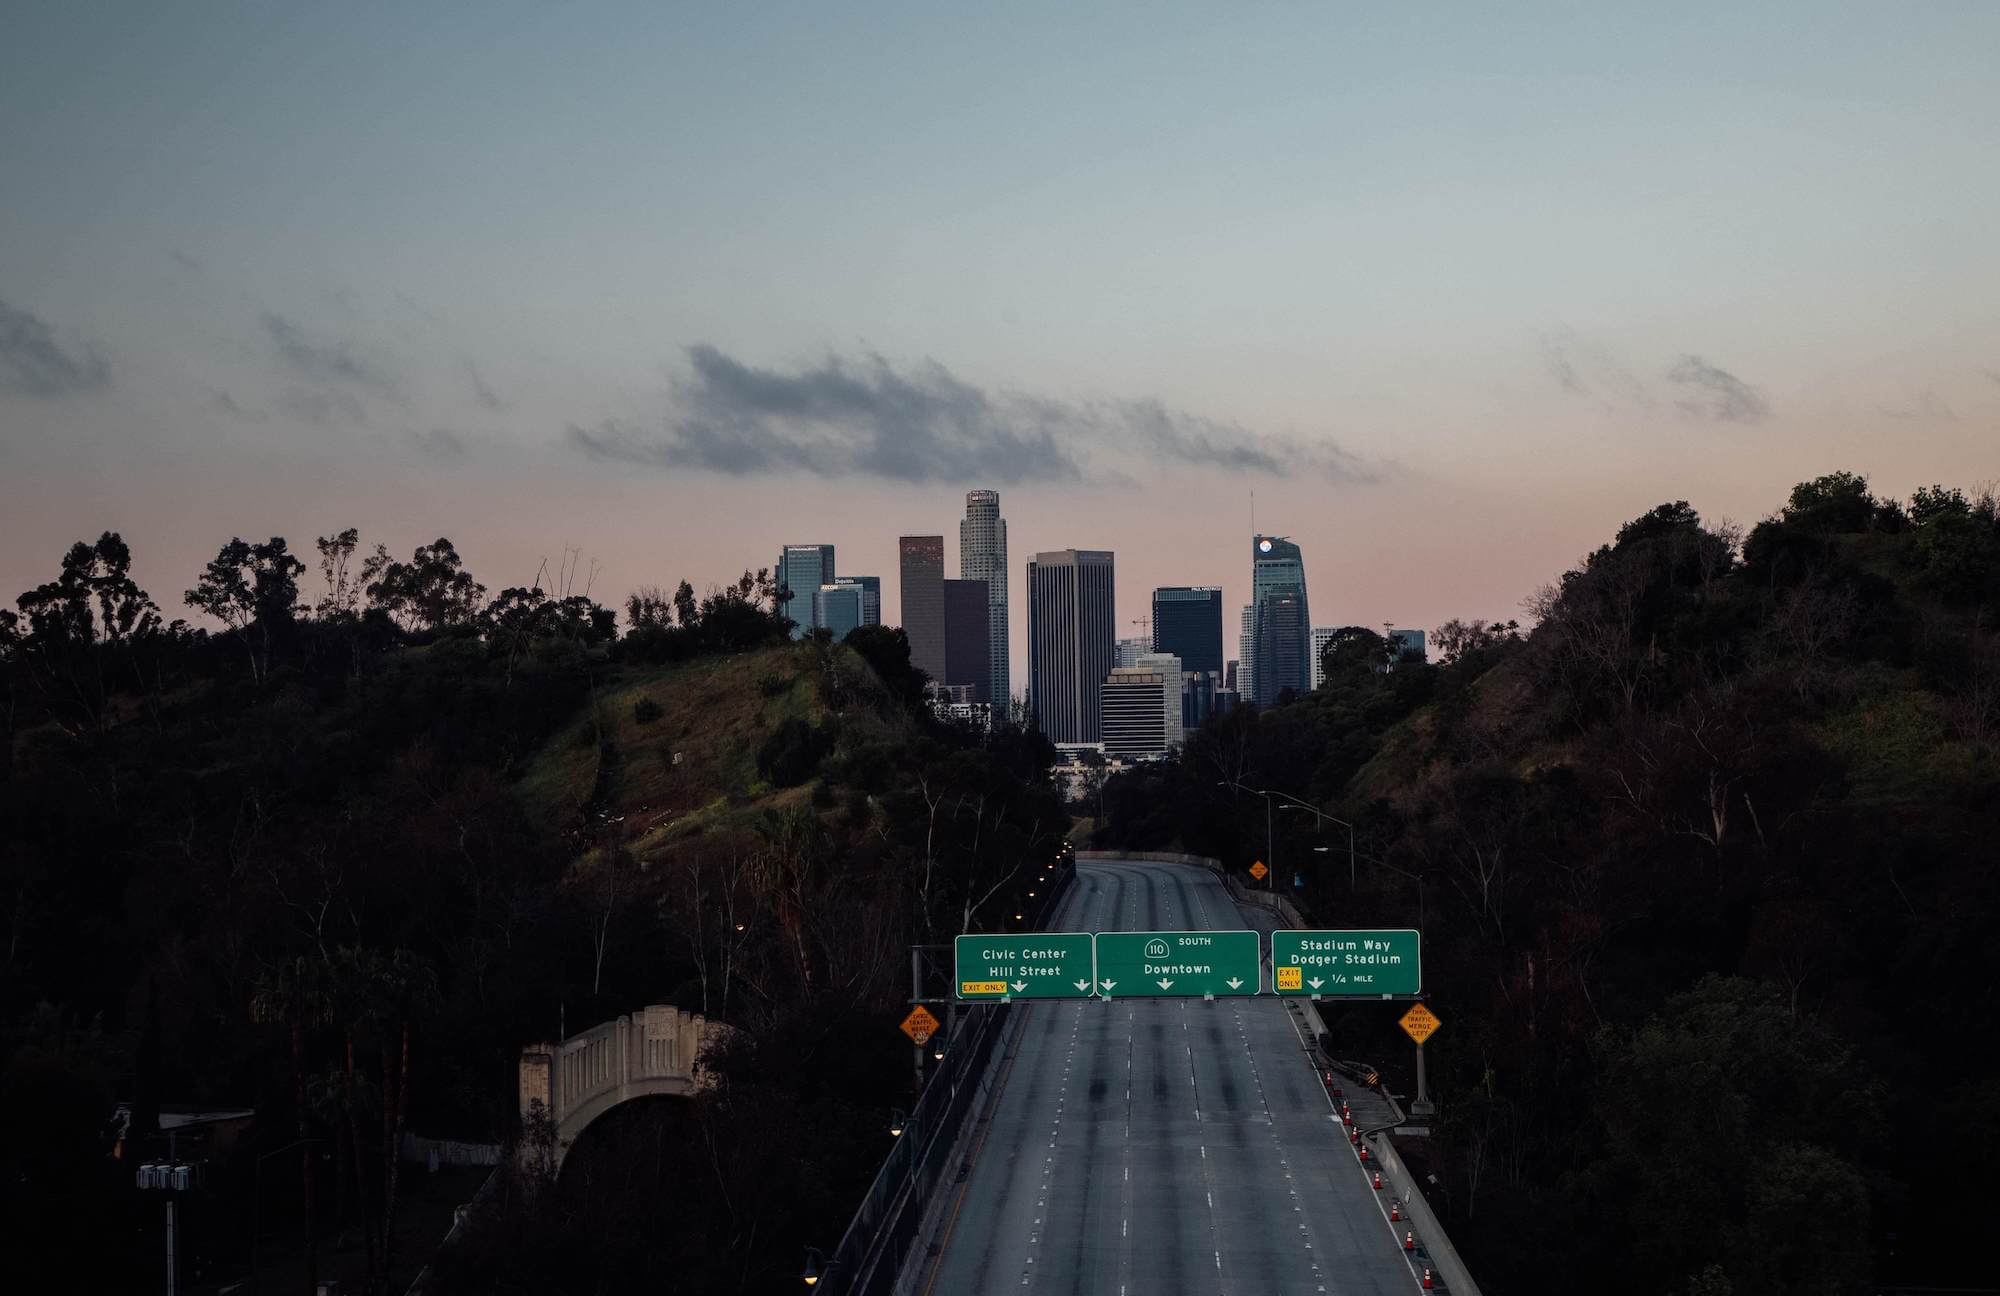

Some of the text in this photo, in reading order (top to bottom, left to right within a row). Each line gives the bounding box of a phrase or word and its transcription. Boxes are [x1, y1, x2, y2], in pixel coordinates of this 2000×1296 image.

[1179, 937, 1211, 946] SOUTH
[1301, 940, 1391, 952] Stadium Way
[982, 949, 1067, 960] Civic Center
[1149, 945, 1165, 955] 110
[1291, 954, 1401, 967] Dodger Stadium
[989, 965, 1061, 977] Hill Street
[1144, 963, 1211, 974] Downtown
[1279, 969, 1300, 977] EXIT
[1332, 974, 1373, 984] 1/4 MILE
[963, 983, 1006, 992] EXIT ONLY
